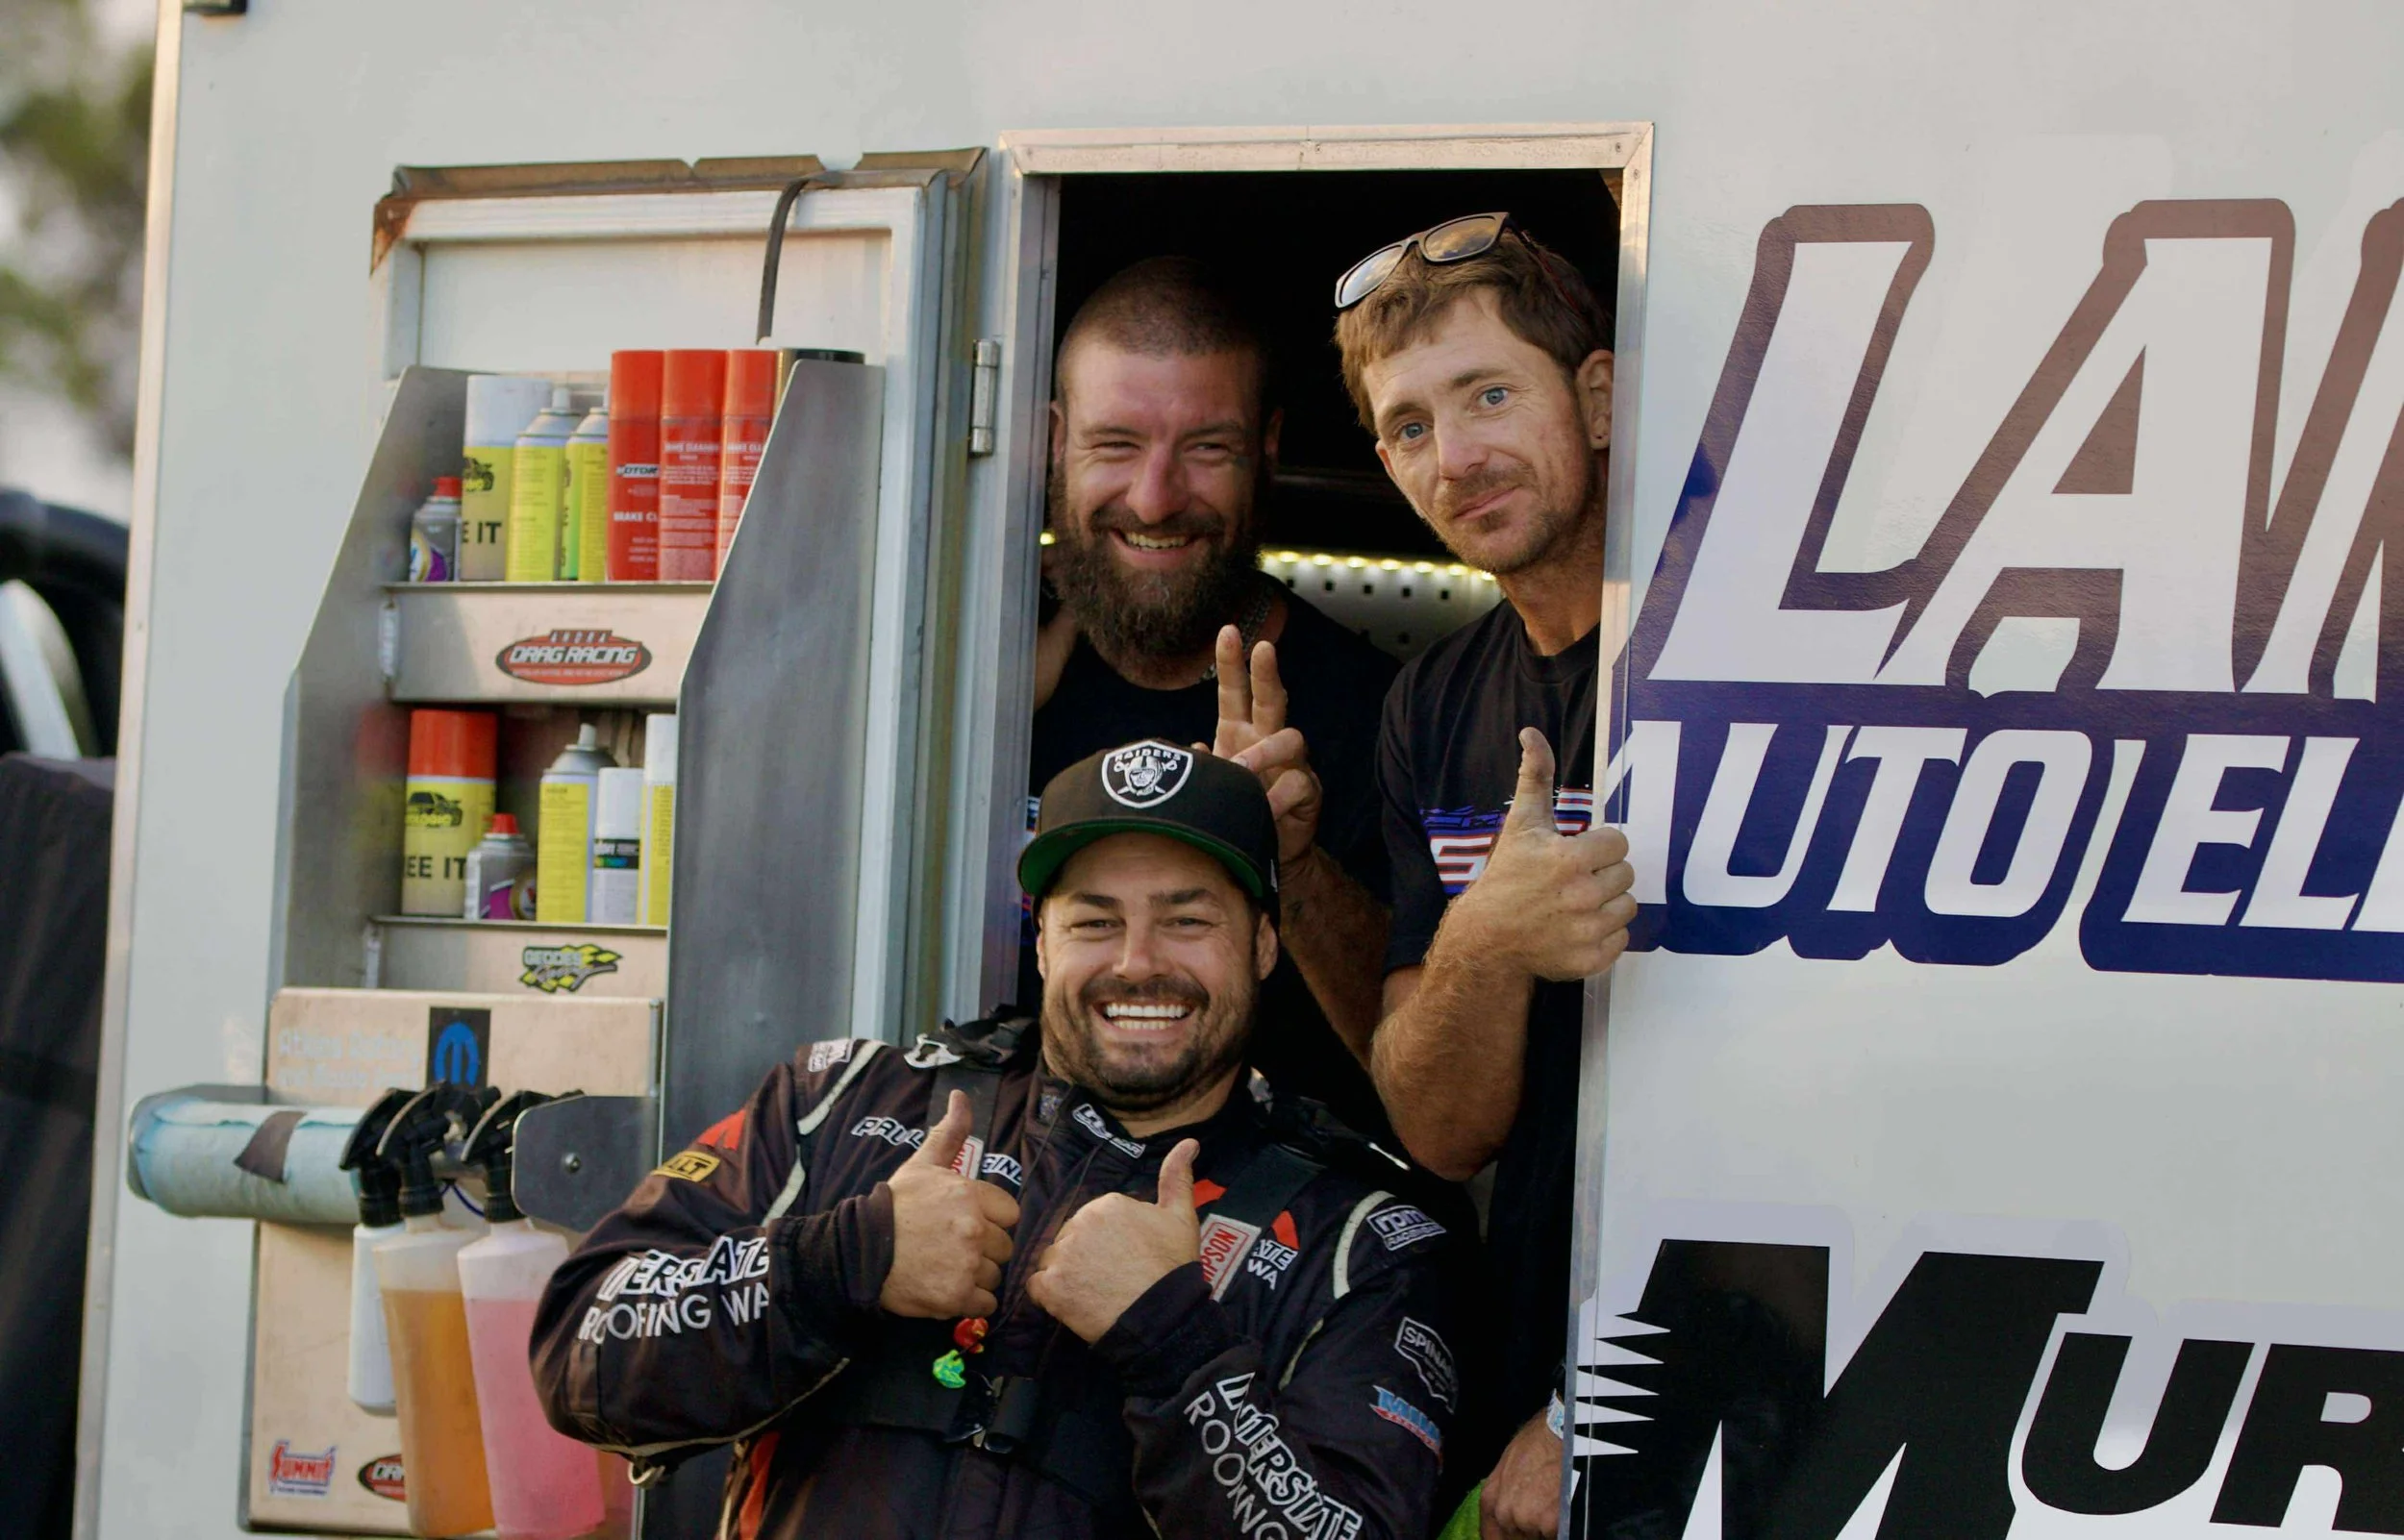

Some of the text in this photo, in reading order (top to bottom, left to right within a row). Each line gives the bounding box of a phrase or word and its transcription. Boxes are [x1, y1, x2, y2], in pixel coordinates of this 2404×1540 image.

[477, 522, 502, 544] IT
[509, 646, 639, 664] DRAG RACING
[1114, 748, 1182, 762] RAIDERS
[1603, 719, 2404, 934] AUTO EL
[443, 857, 466, 881] IT
[1247, 1258, 1278, 1290] WA
[578, 1281, 770, 1345] ROOFING WA
